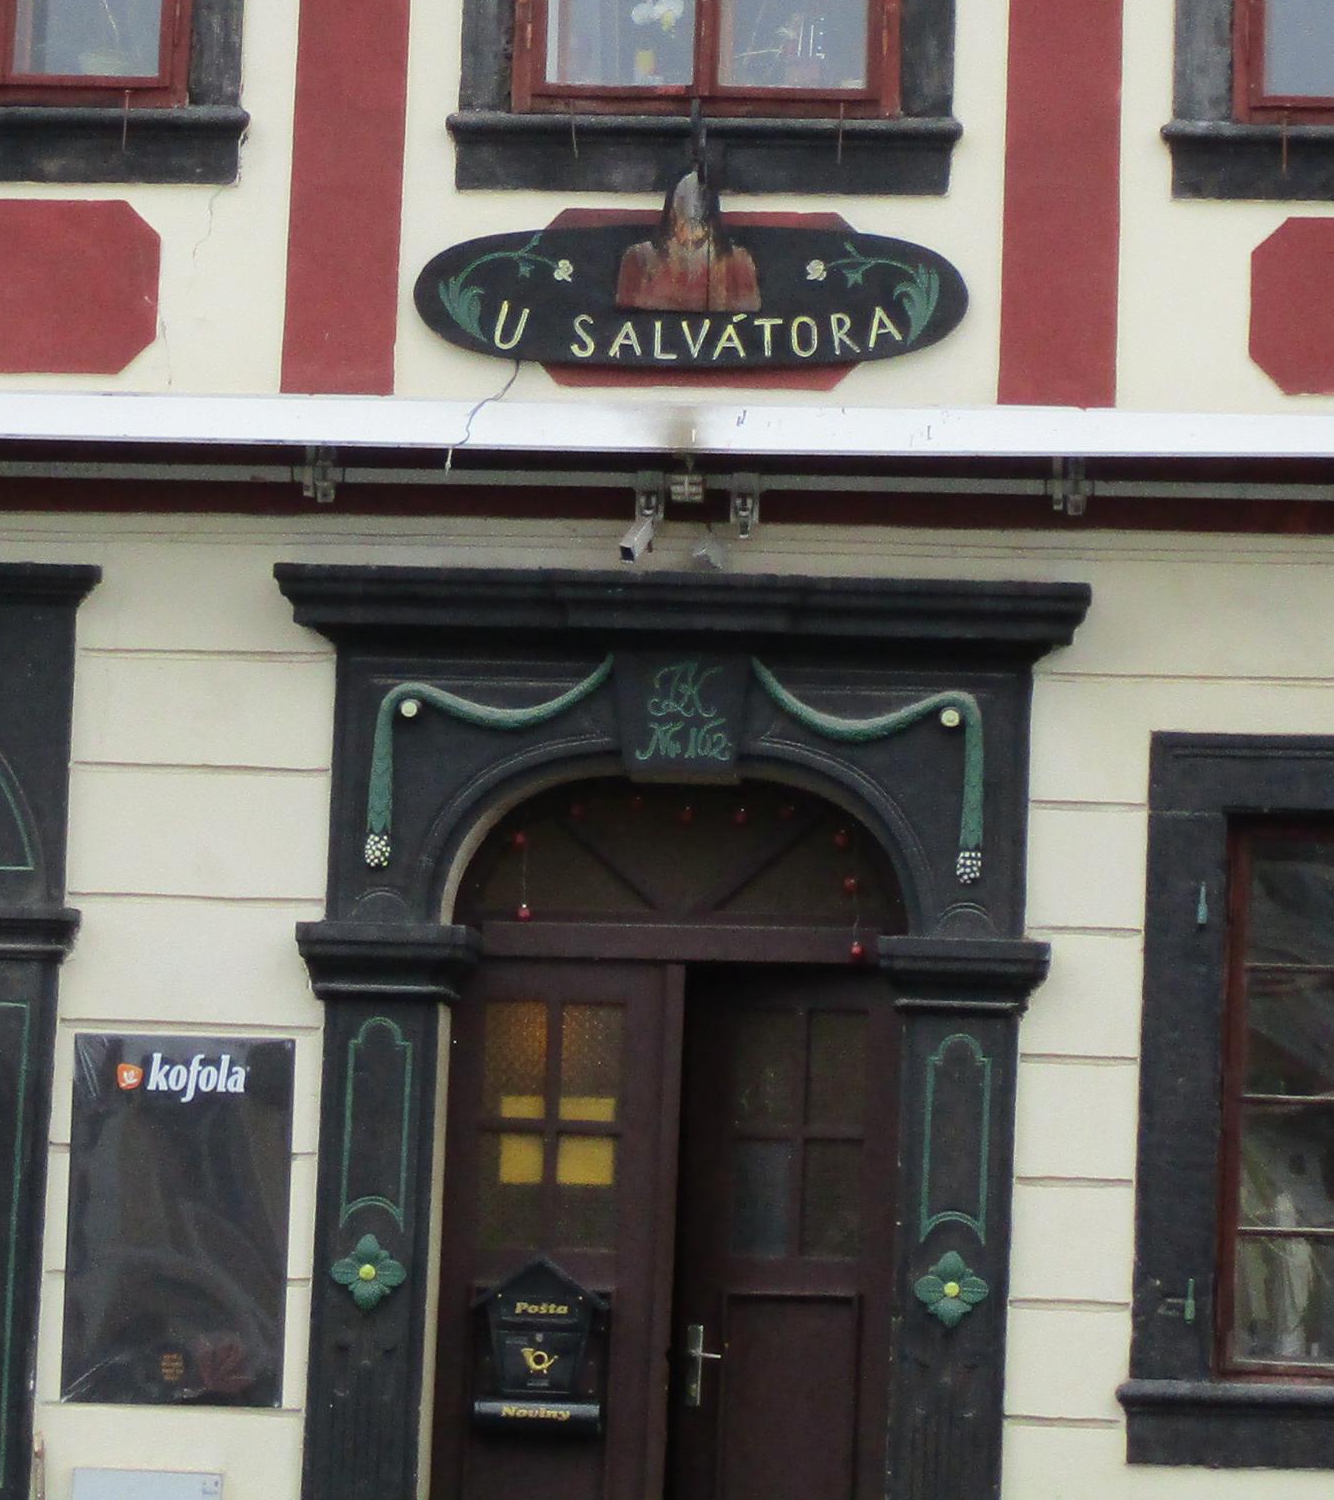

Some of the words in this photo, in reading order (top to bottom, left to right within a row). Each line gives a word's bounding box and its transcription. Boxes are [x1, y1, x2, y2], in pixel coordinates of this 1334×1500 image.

[492, 300, 531, 350] U
[570, 305, 904, 361] SALVÁTORA
[147, 1052, 247, 1102] kofola
[514, 1301, 569, 1315] Pošta
[500, 1406, 571, 1420] Noviny
